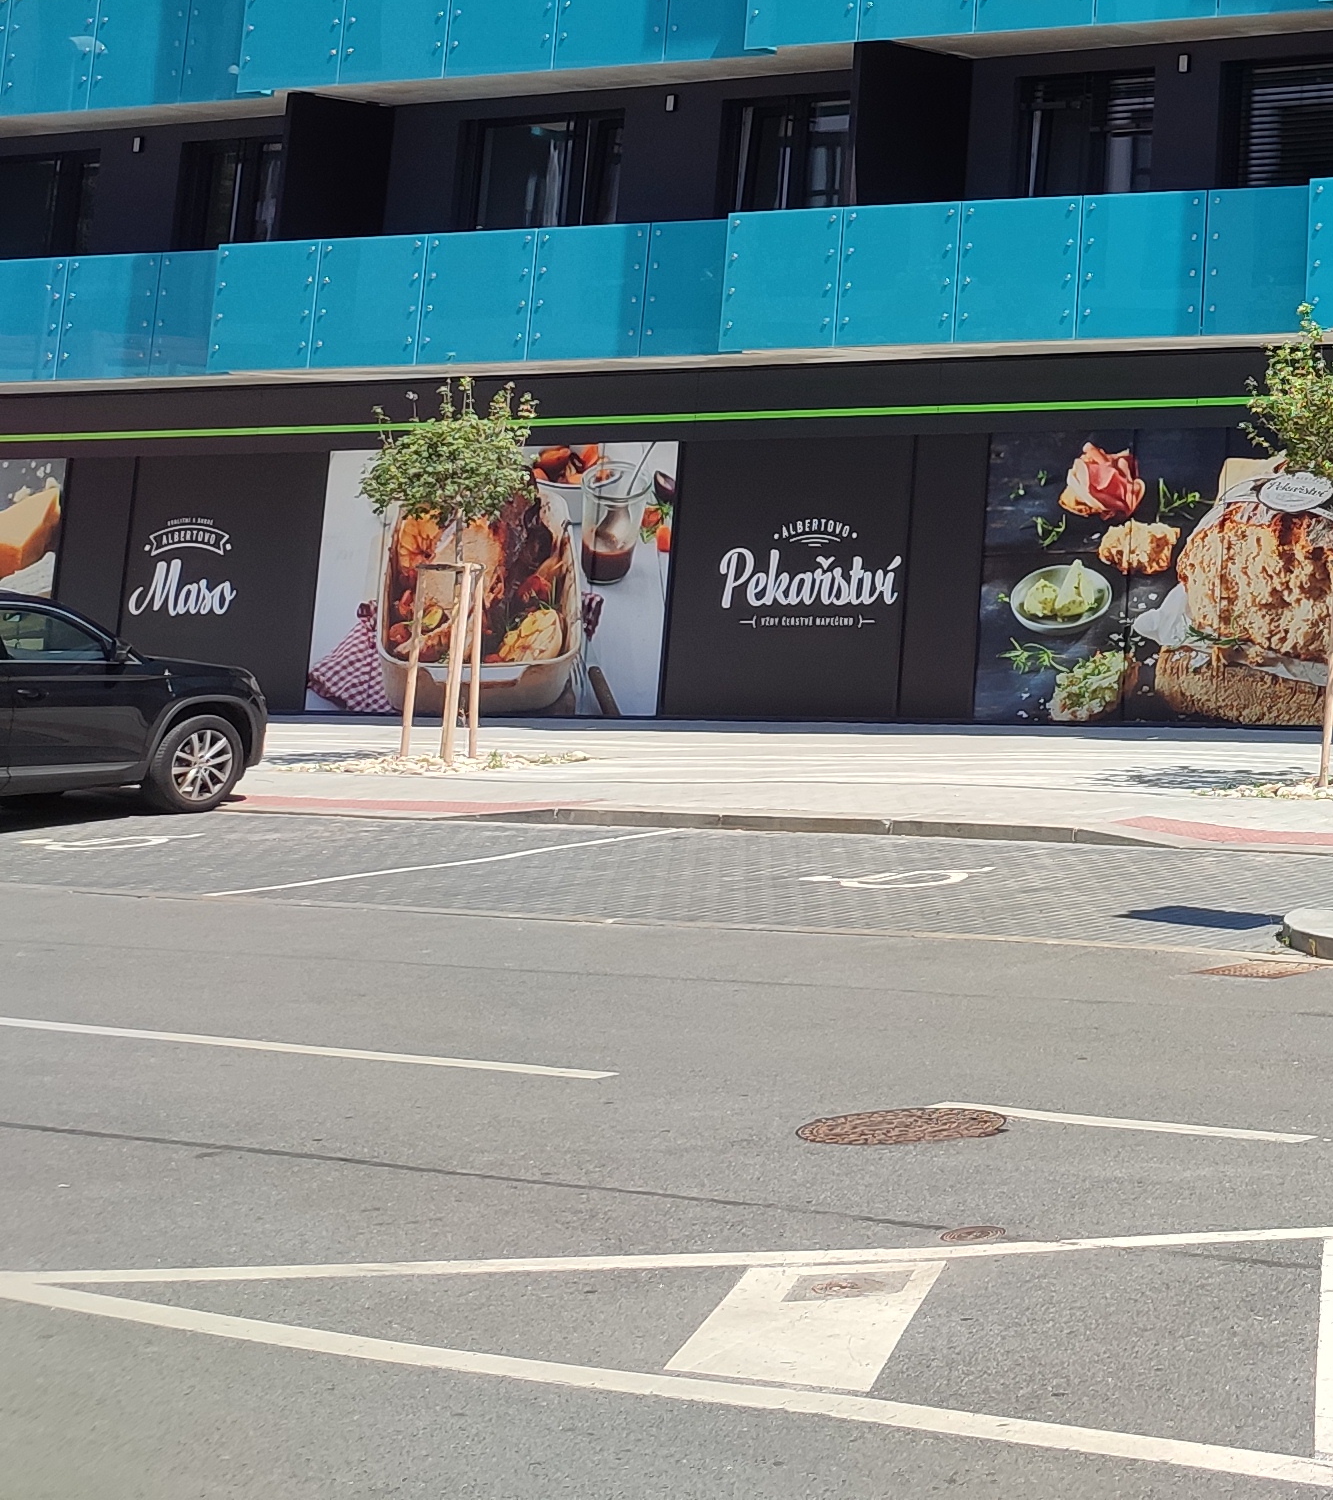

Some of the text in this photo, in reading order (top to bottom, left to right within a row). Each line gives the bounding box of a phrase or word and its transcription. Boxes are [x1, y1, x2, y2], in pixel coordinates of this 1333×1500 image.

[161, 530, 216, 546] ALBERTOVO
[781, 518, 850, 539] ALBERTOVO
[128, 558, 237, 617] Maso
[719, 547, 902, 609] Pekařství
